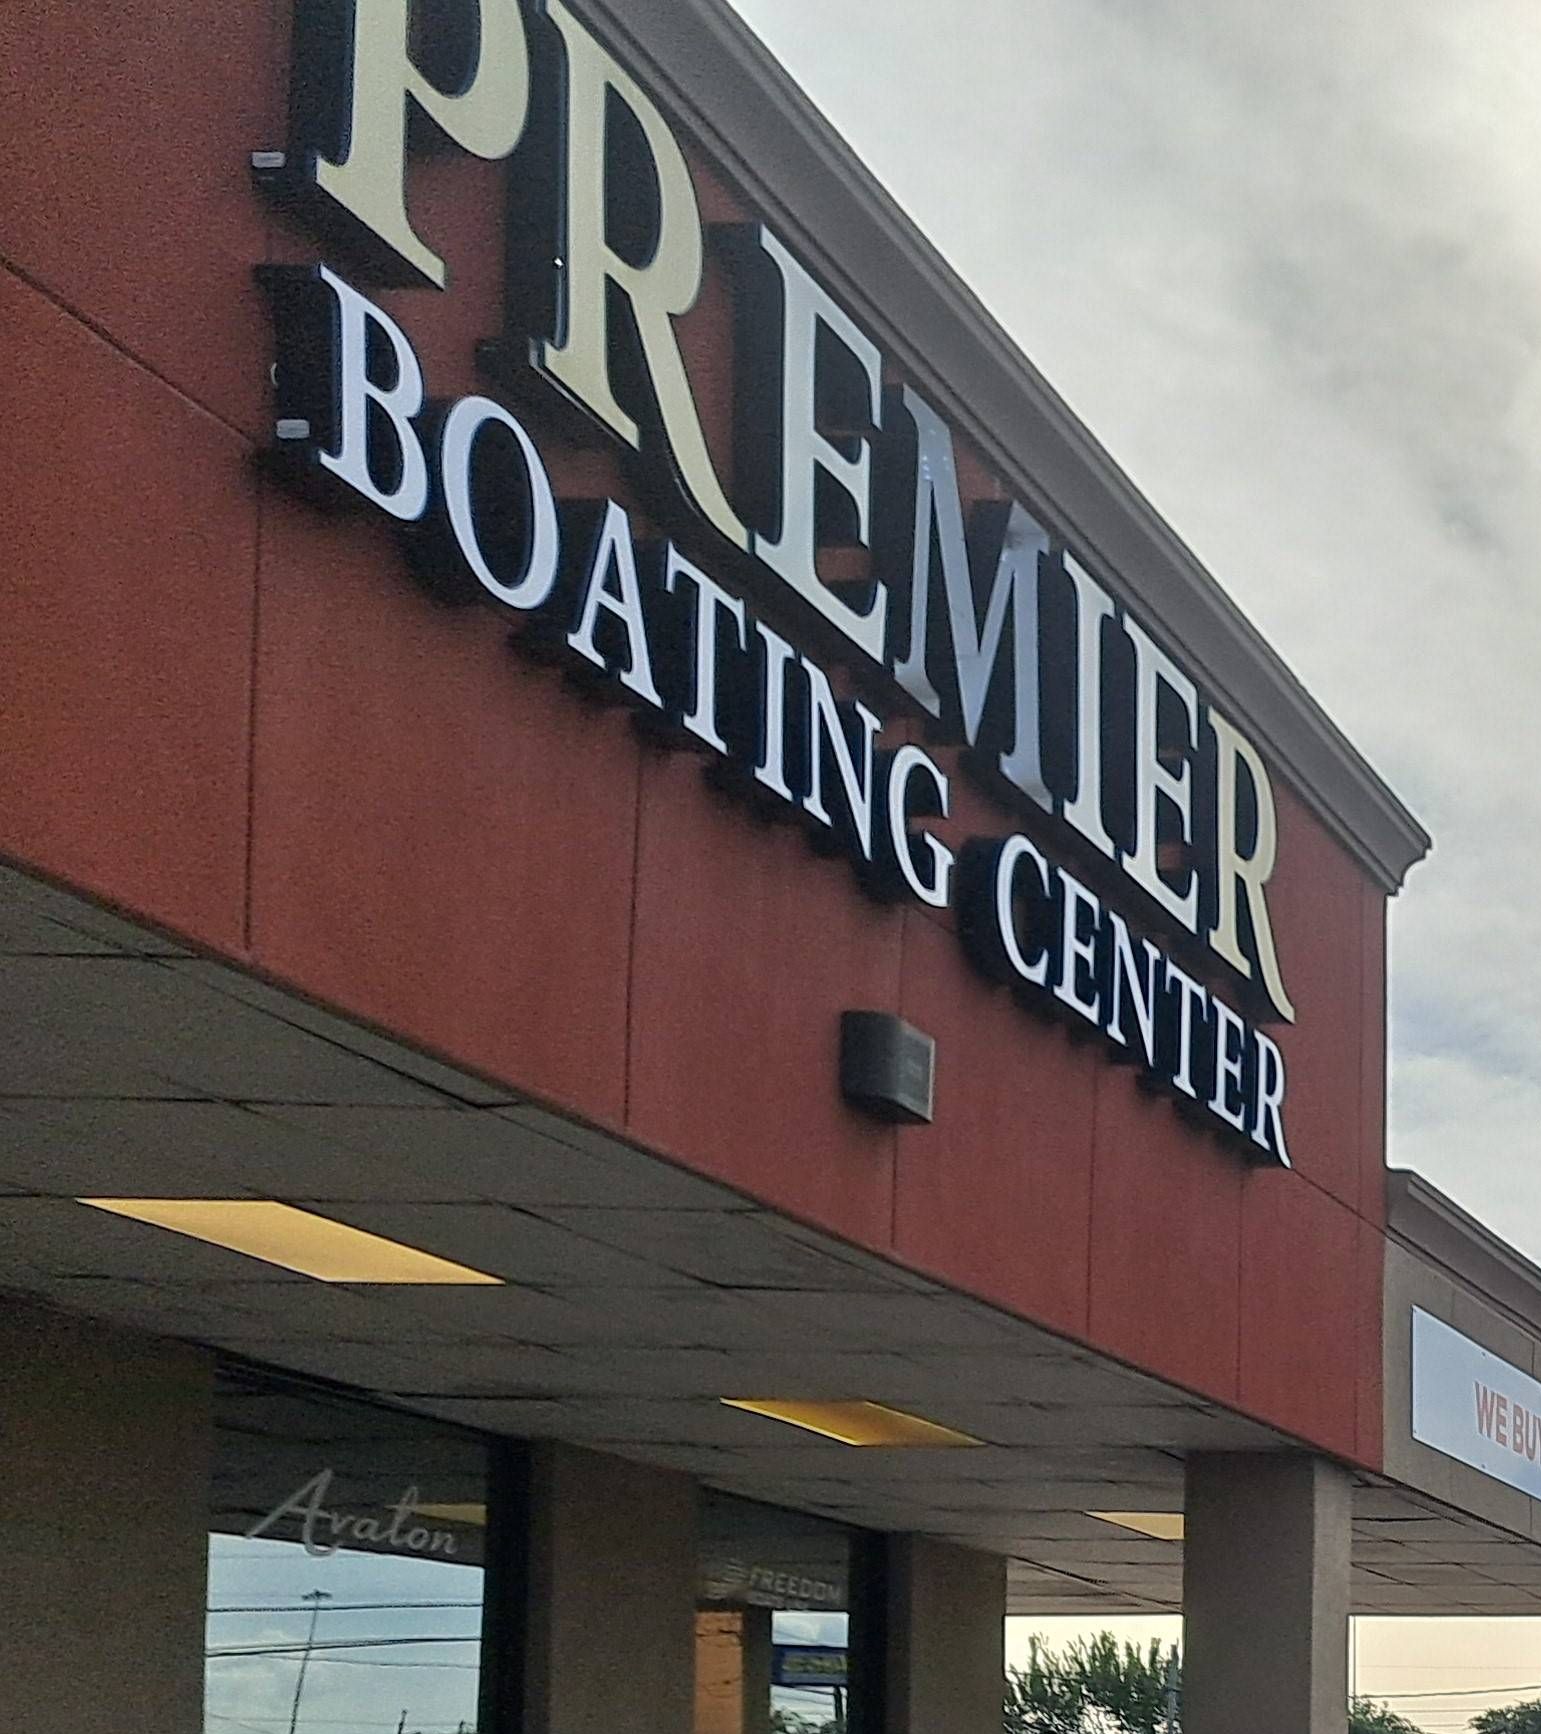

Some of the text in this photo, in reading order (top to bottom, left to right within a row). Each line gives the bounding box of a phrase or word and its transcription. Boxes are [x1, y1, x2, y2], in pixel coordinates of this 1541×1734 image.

[314, 0, 1296, 1022] PREMIER
[317, 264, 1292, 1169] BOATING CENTER
[750, 1566, 843, 1602] FREEDOM
[1474, 1380, 1508, 1447] WE
